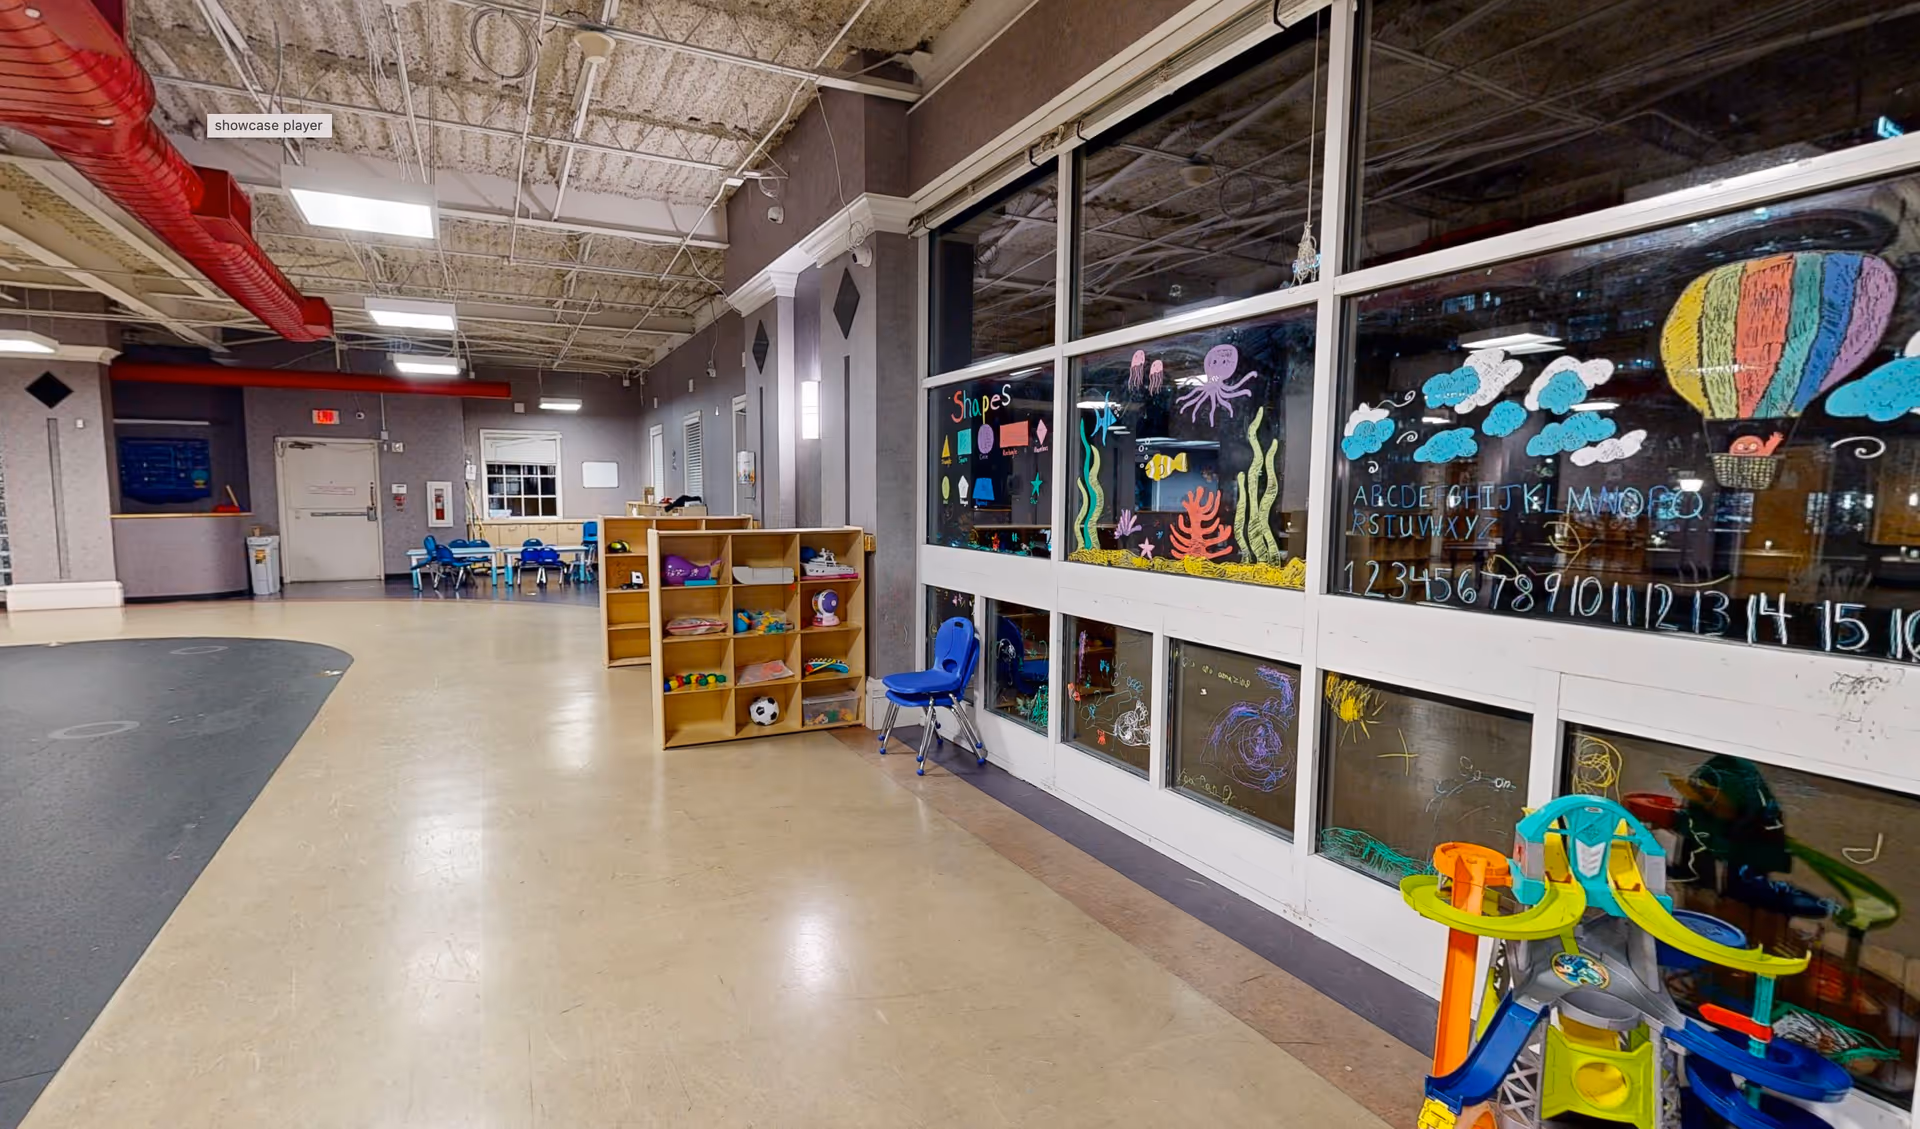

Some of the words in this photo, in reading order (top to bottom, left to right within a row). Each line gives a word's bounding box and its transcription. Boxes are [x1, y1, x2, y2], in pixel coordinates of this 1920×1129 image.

[1344, 561, 1354, 593] 1
[1364, 560, 1385, 598] 2
[1388, 562, 1407, 599] 3
[1409, 566, 1431, 600] 4
[1433, 568, 1452, 602] 5
[1458, 569, 1477, 603] 6
[1480, 571, 1506, 609] 7
[1511, 575, 1534, 612] 8
[1545, 573, 1561, 612] 9
[1570, 575, 1603, 616] 10
[1612, 582, 1635, 626] 11
[1646, 583, 1678, 630] 12
[1692, 590, 1731, 636] 13
[1747, 592, 1793, 646] 14
[1816, 600, 1869, 652] 15
